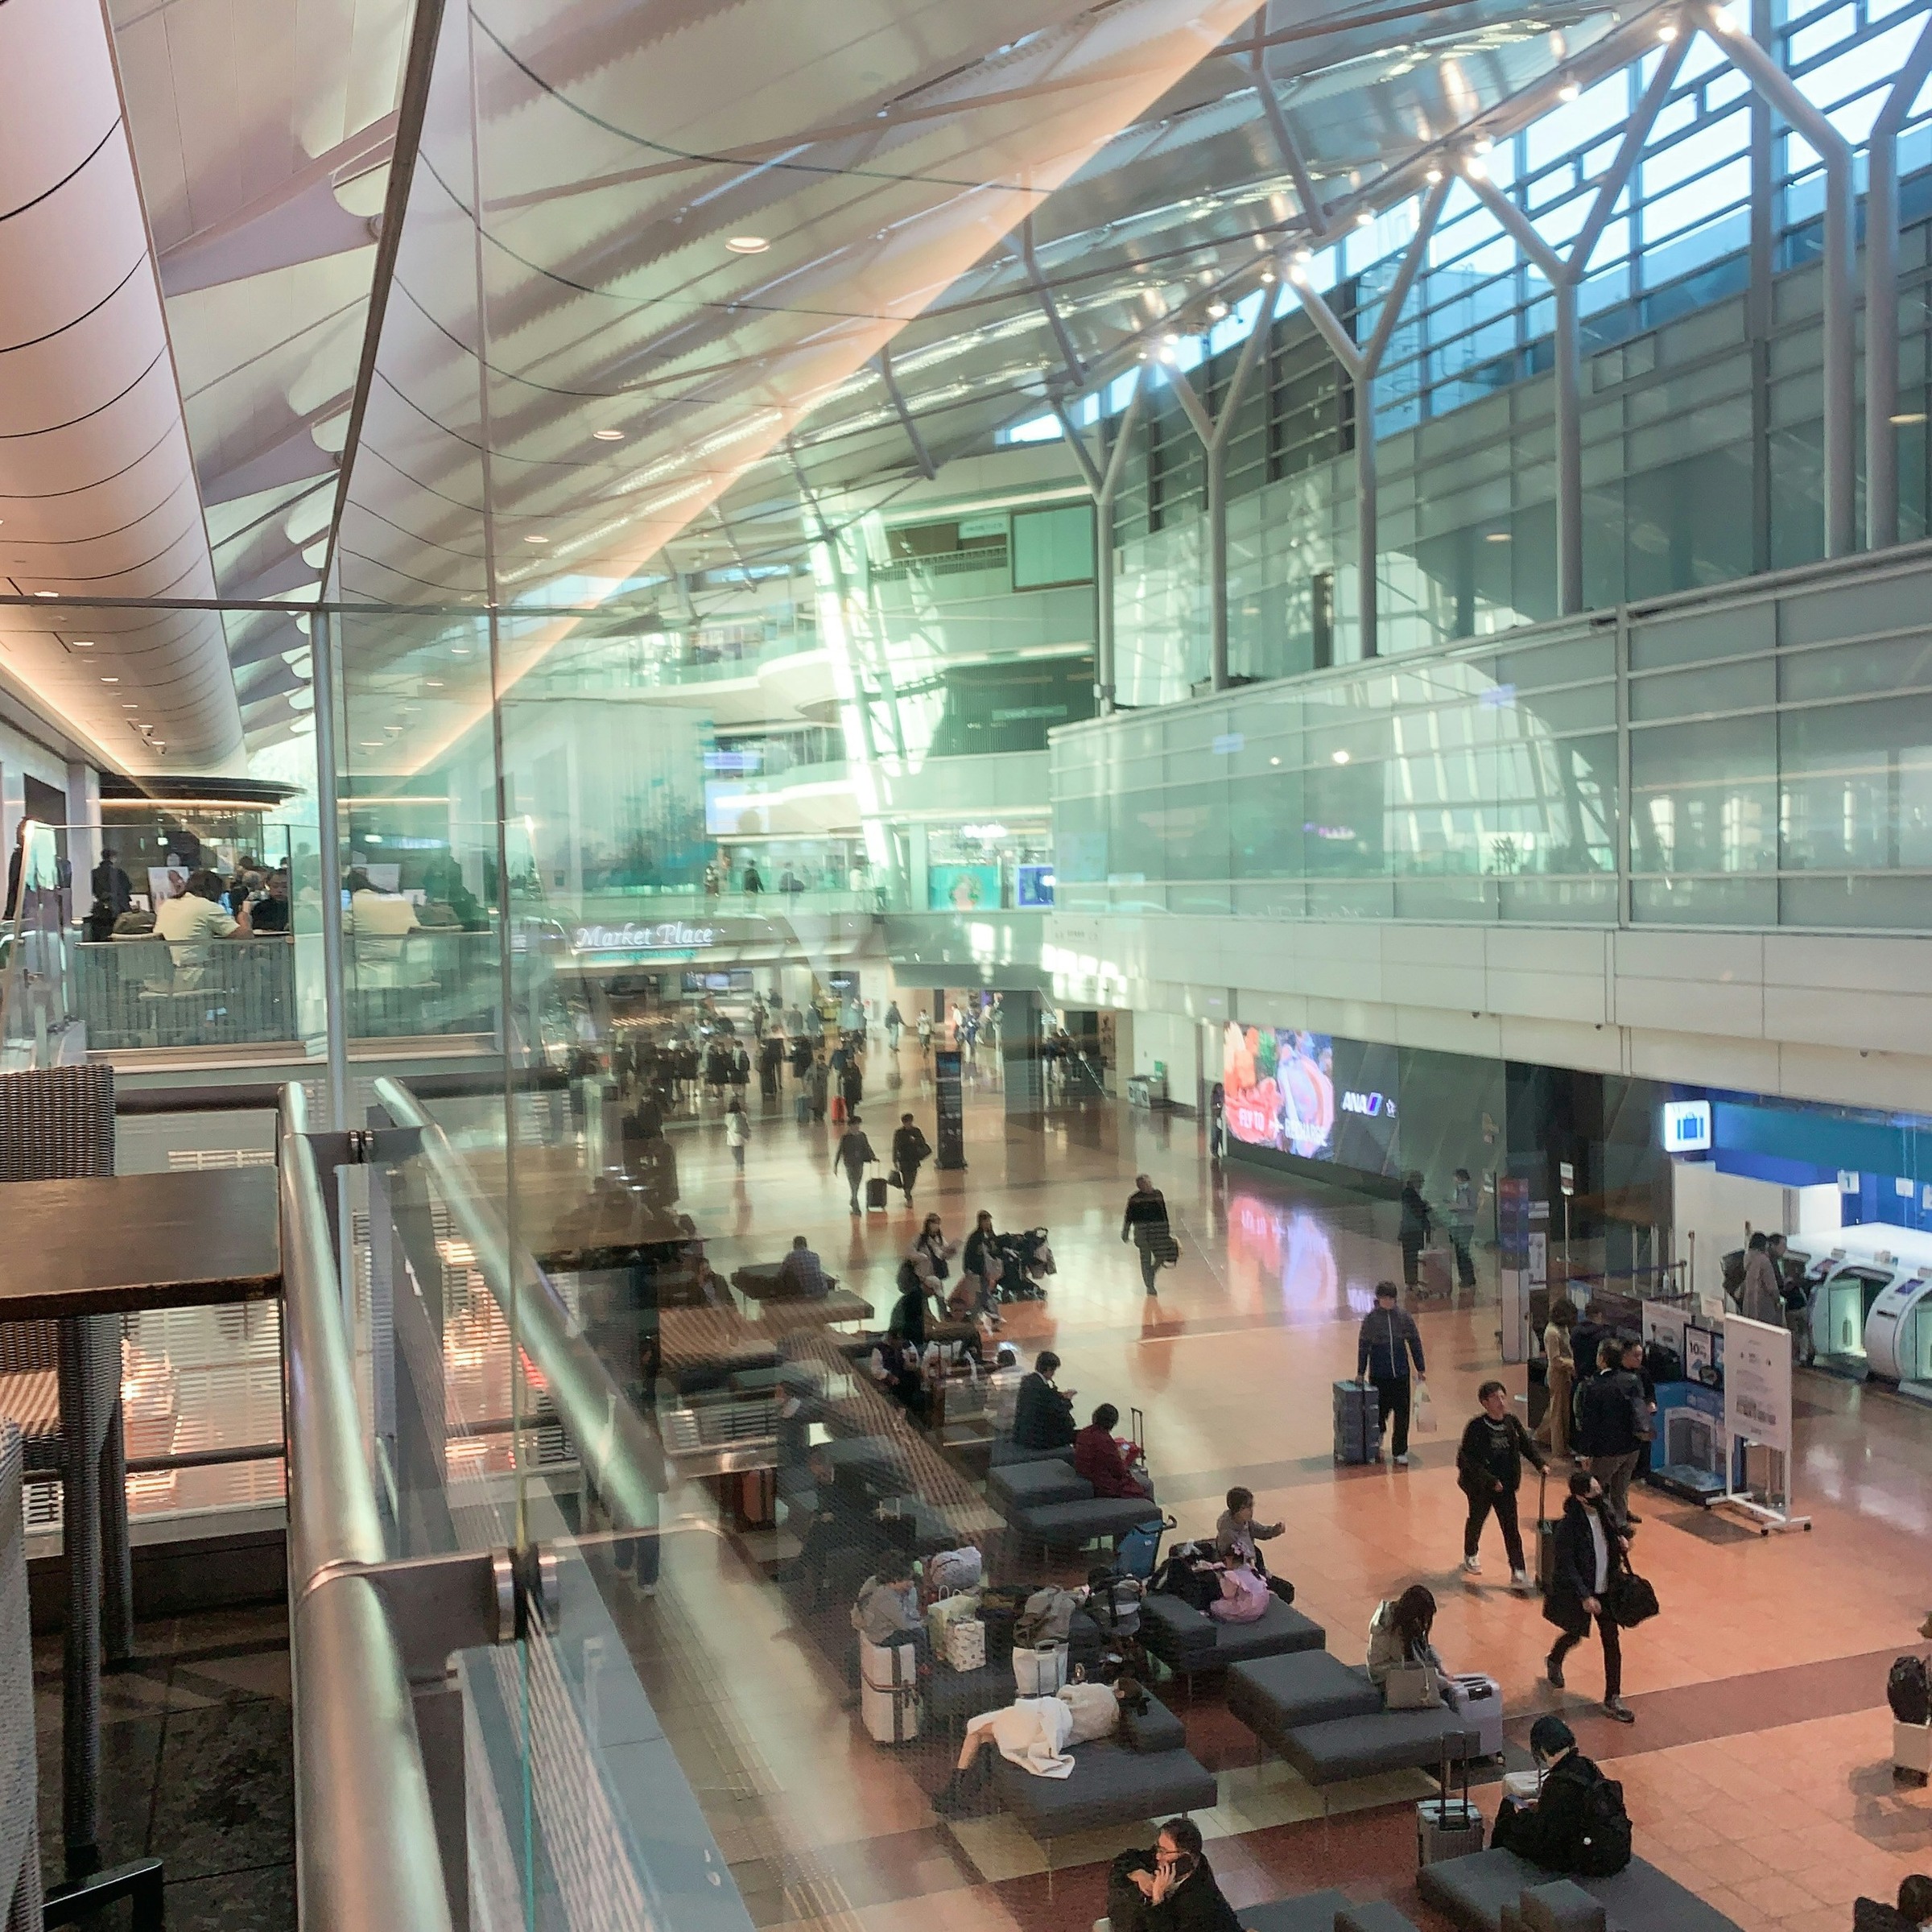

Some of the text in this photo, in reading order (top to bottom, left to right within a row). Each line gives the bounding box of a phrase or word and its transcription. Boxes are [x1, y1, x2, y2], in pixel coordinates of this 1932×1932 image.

[575, 921, 713, 947] Market Place
[1342, 1092, 1368, 1114] ANA
